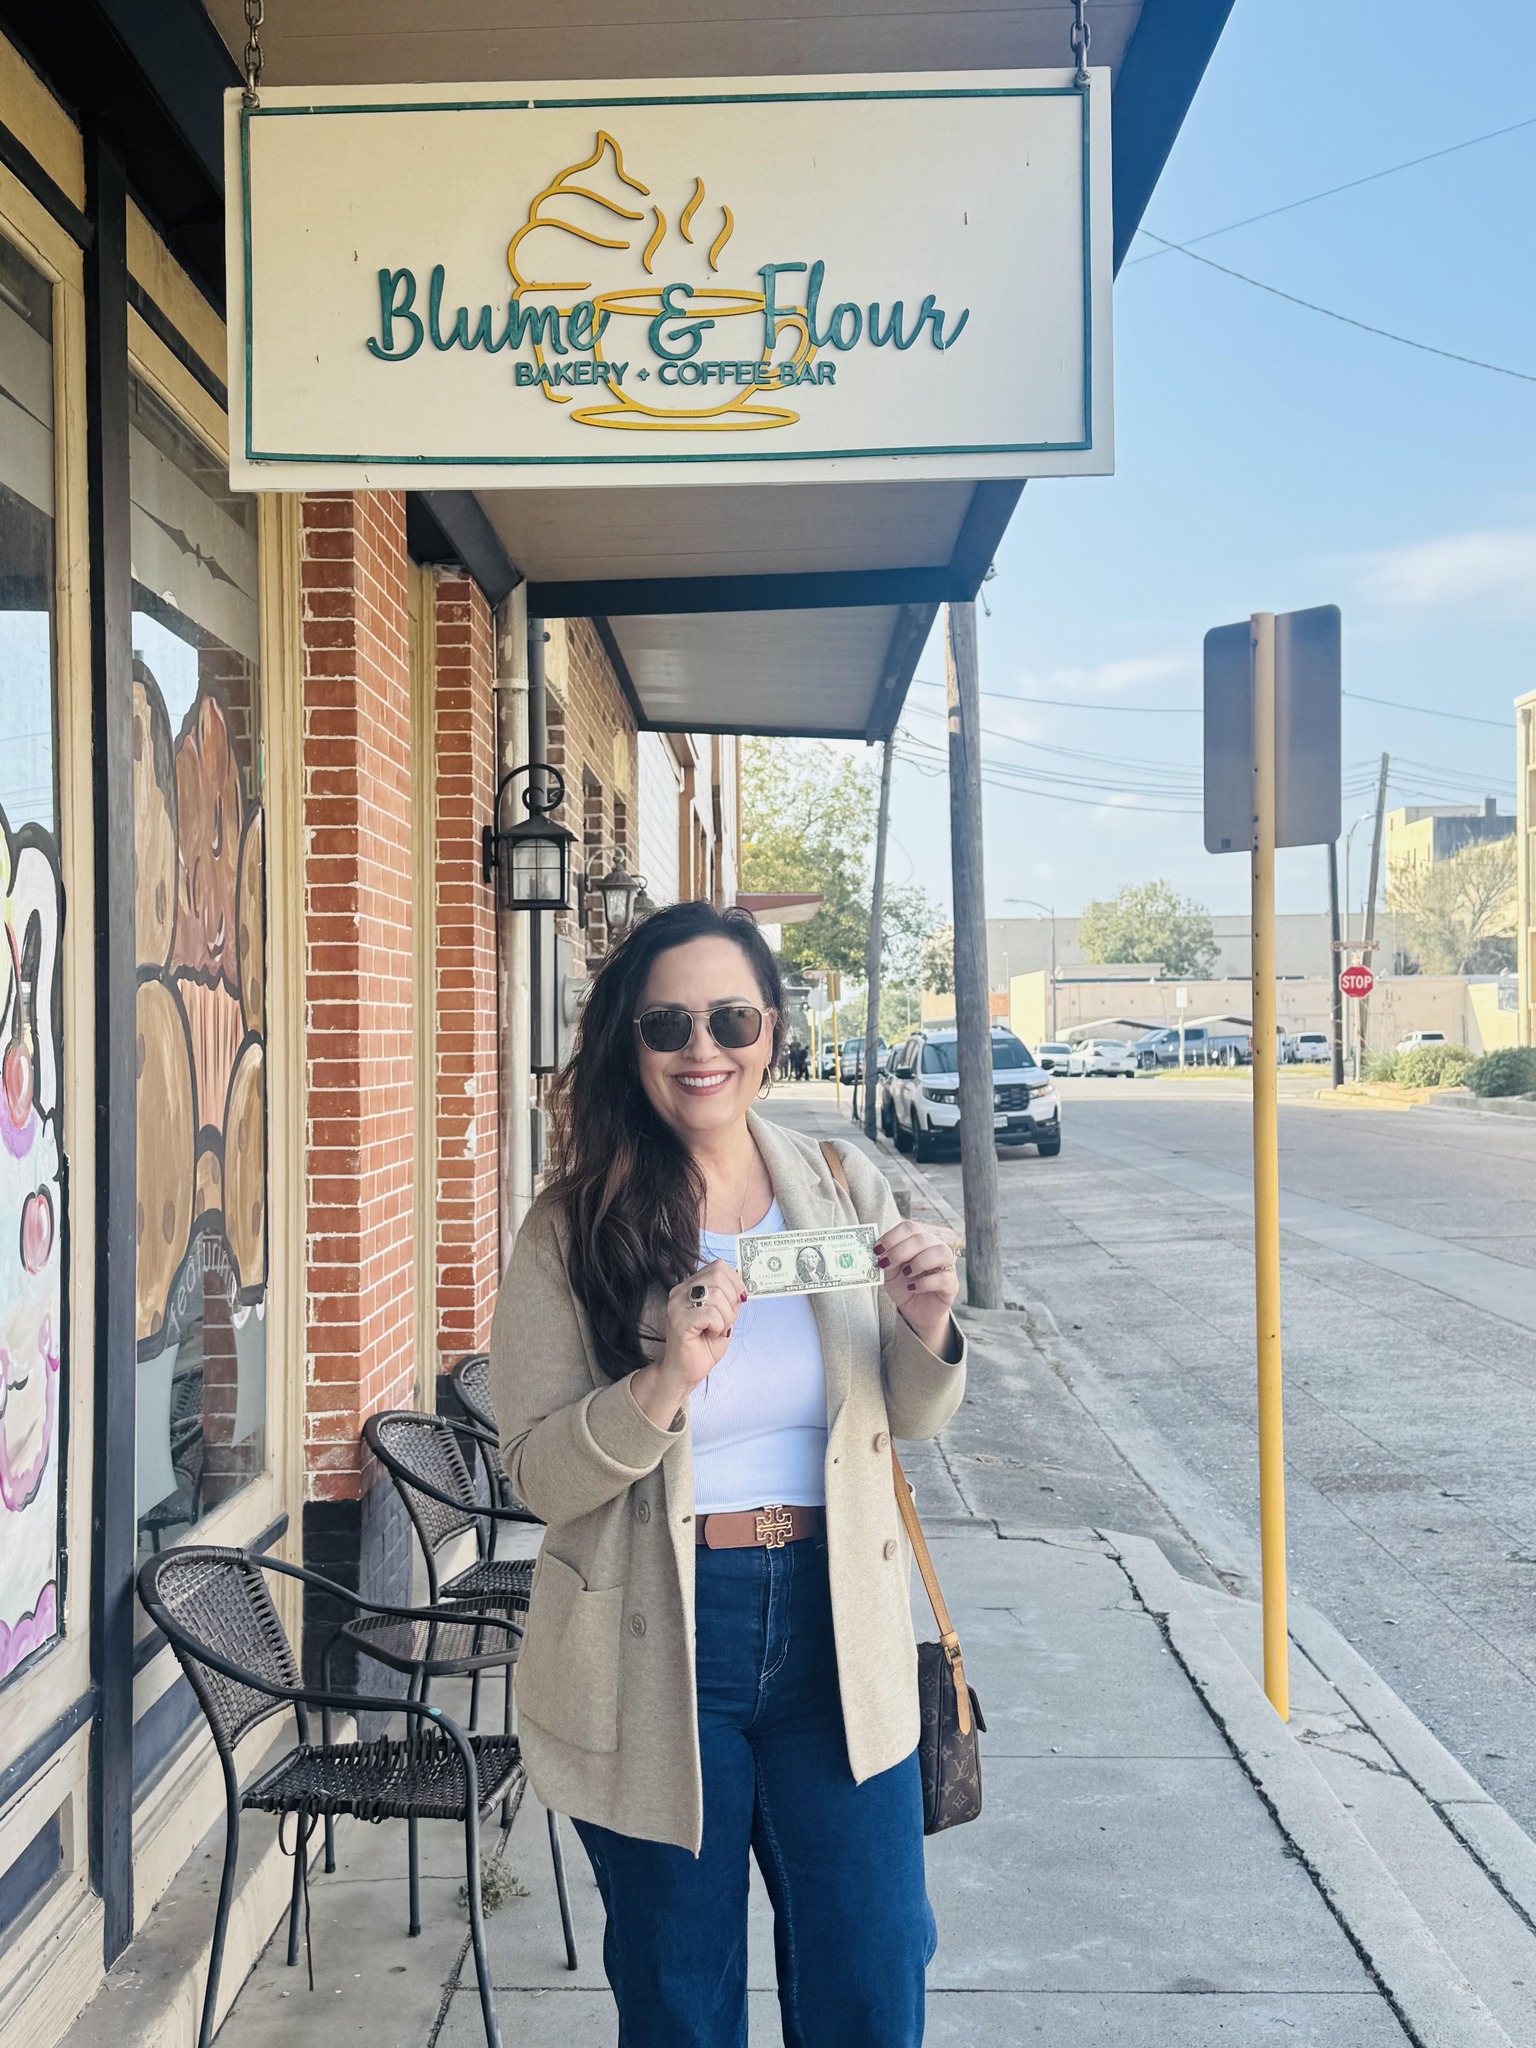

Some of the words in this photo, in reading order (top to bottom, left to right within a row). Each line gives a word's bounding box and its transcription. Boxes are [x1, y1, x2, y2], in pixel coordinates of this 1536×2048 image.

[367, 264, 611, 361] Blume
[649, 282, 715, 361] &
[758, 259, 970, 352] Flour
[515, 360, 629, 386] BAKERY
[659, 360, 770, 386] COFFEE
[778, 361, 837, 386] BAR
[1342, 975, 1372, 989] STOP
